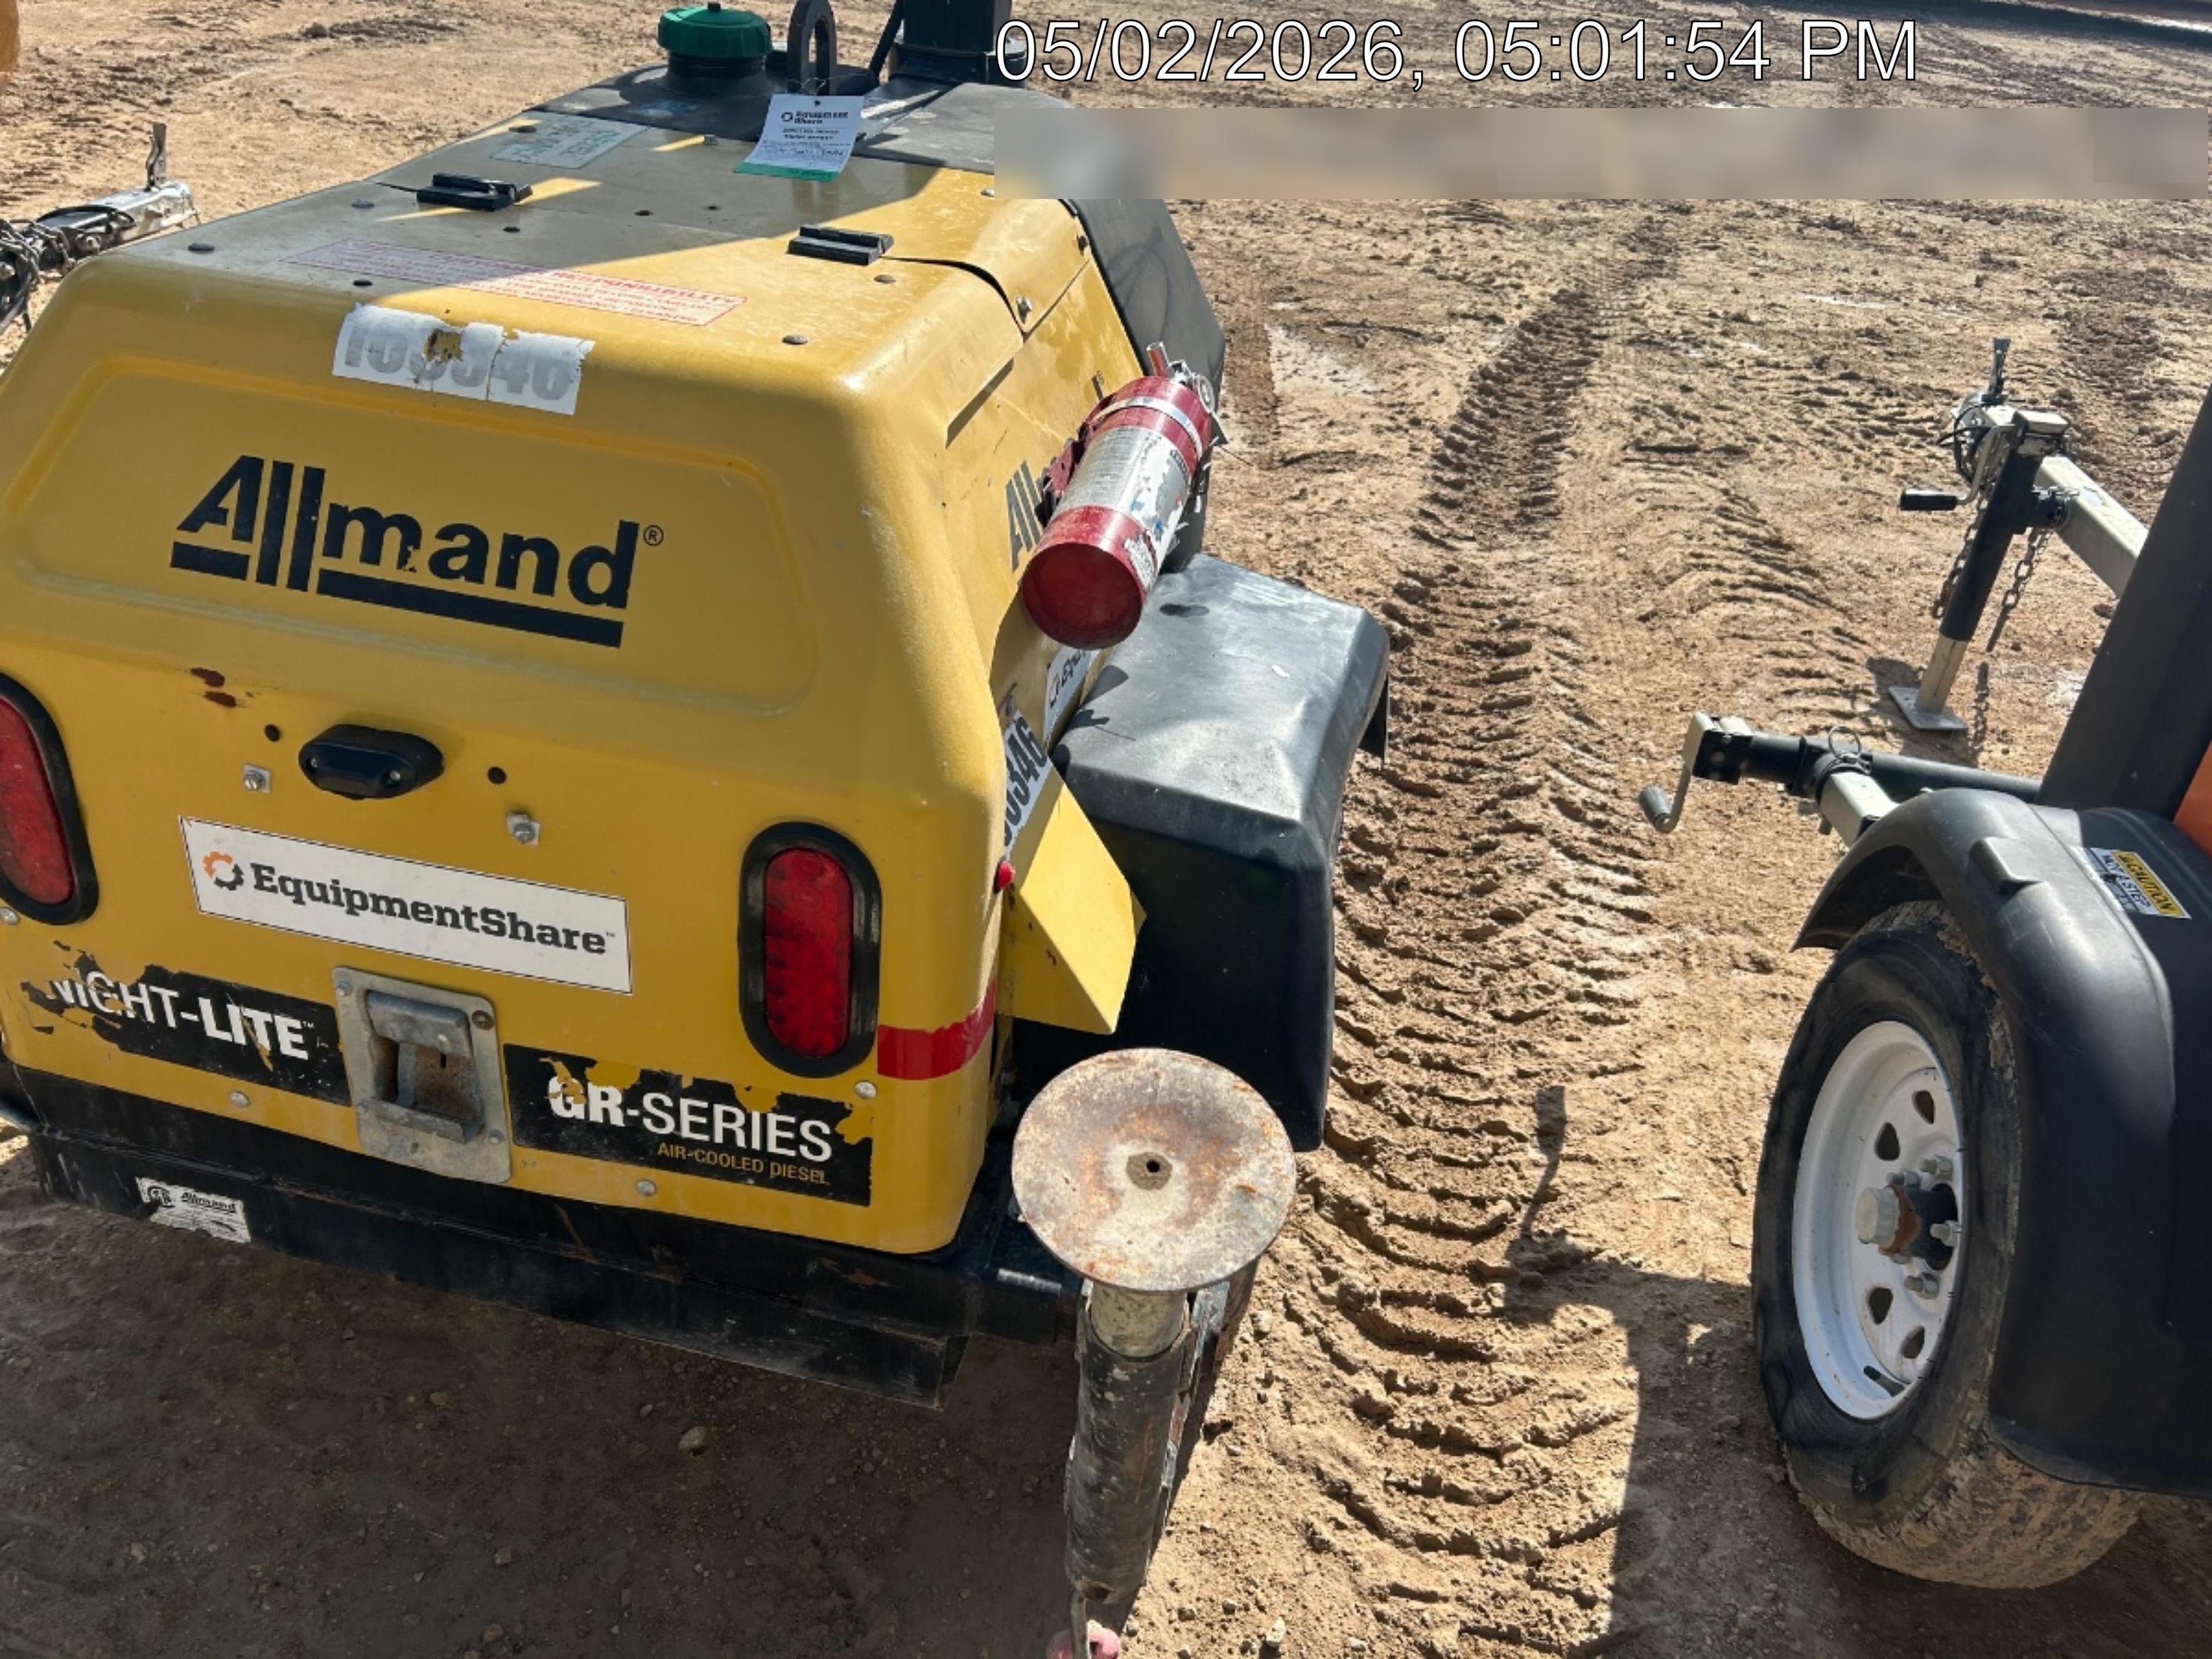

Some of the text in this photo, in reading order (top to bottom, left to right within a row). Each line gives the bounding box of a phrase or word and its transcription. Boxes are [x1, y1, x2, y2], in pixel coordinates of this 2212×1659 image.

[549, 1075, 833, 1164] GR-SERIES
[657, 1142, 830, 1185] AIR-COOLED DIESEL
